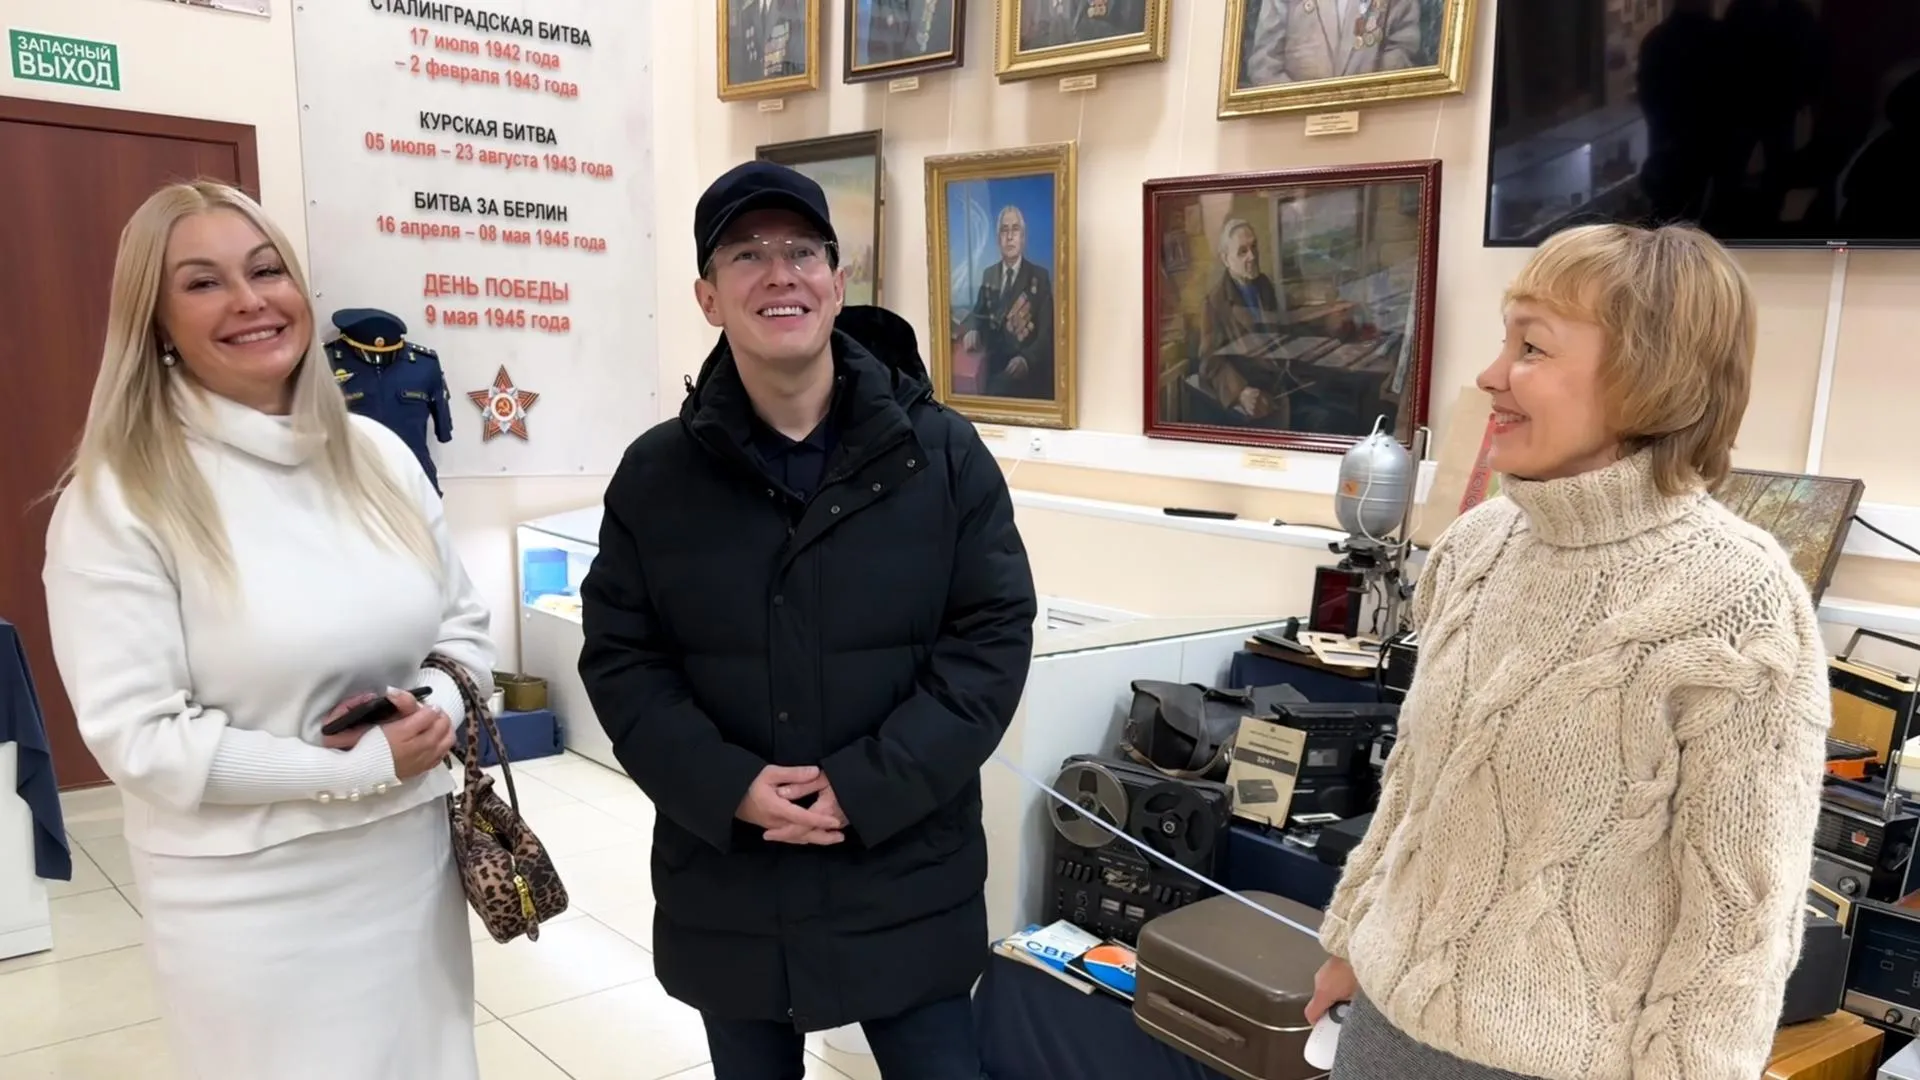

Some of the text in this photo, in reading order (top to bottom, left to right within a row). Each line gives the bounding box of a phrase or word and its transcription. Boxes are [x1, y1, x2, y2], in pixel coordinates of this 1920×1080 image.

[370, 0, 593, 48] СТАЛИНГРАДСКАЯ БИТВА
[17, 35, 112, 62] ЗАПАСНЫЙ
[410, 26, 561, 70] 17 июля 1942 года
[18, 50, 114, 87] ВЫХОД
[410, 55, 421, 73] 2
[425, 57, 500, 85] февраля
[505, 69, 541, 90] 1943
[544, 78, 579, 98] года
[419, 110, 558, 145] КУРСКАЯ БИТВА
[364, 131, 385, 151] 05
[390, 137, 437, 158] июля
[455, 143, 474, 161] 23
[478, 148, 539, 170] августа
[543, 153, 577, 173] 1943
[581, 160, 614, 179] года
[414, 191, 569, 222] БИТВА ЗА БЕРЛИН
[376, 215, 396, 233] 16
[400, 219, 461, 240] апреля
[479, 223, 497, 242] 08
[502, 229, 531, 244] мая
[535, 229, 570, 247] 1945
[573, 235, 607, 253] года
[423, 273, 569, 302] ДЕНЬ ПОБЕДЫ
[424, 304, 571, 333] 9 мая 1945 года
